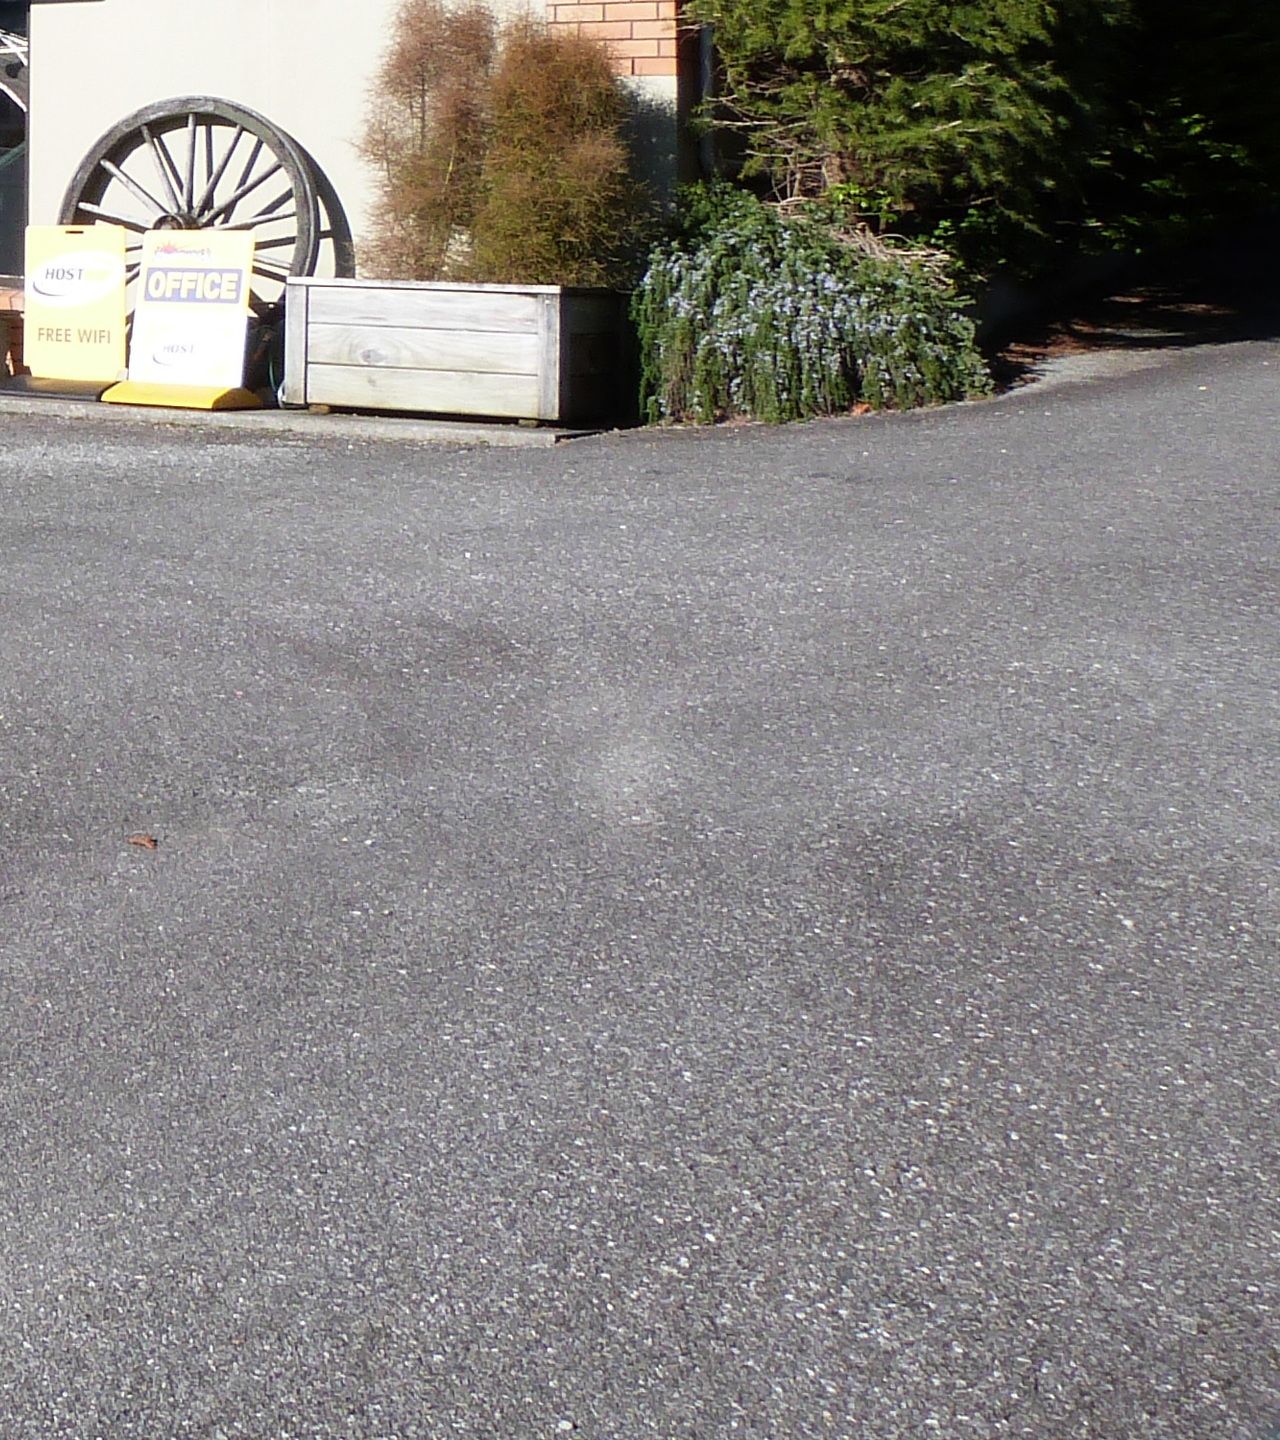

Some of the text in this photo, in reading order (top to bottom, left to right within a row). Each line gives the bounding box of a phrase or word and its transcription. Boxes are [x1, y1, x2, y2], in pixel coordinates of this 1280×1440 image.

[44, 267, 85, 281] HOST
[147, 270, 240, 300] OFFICE
[37, 327, 112, 344] FREE WIFI
